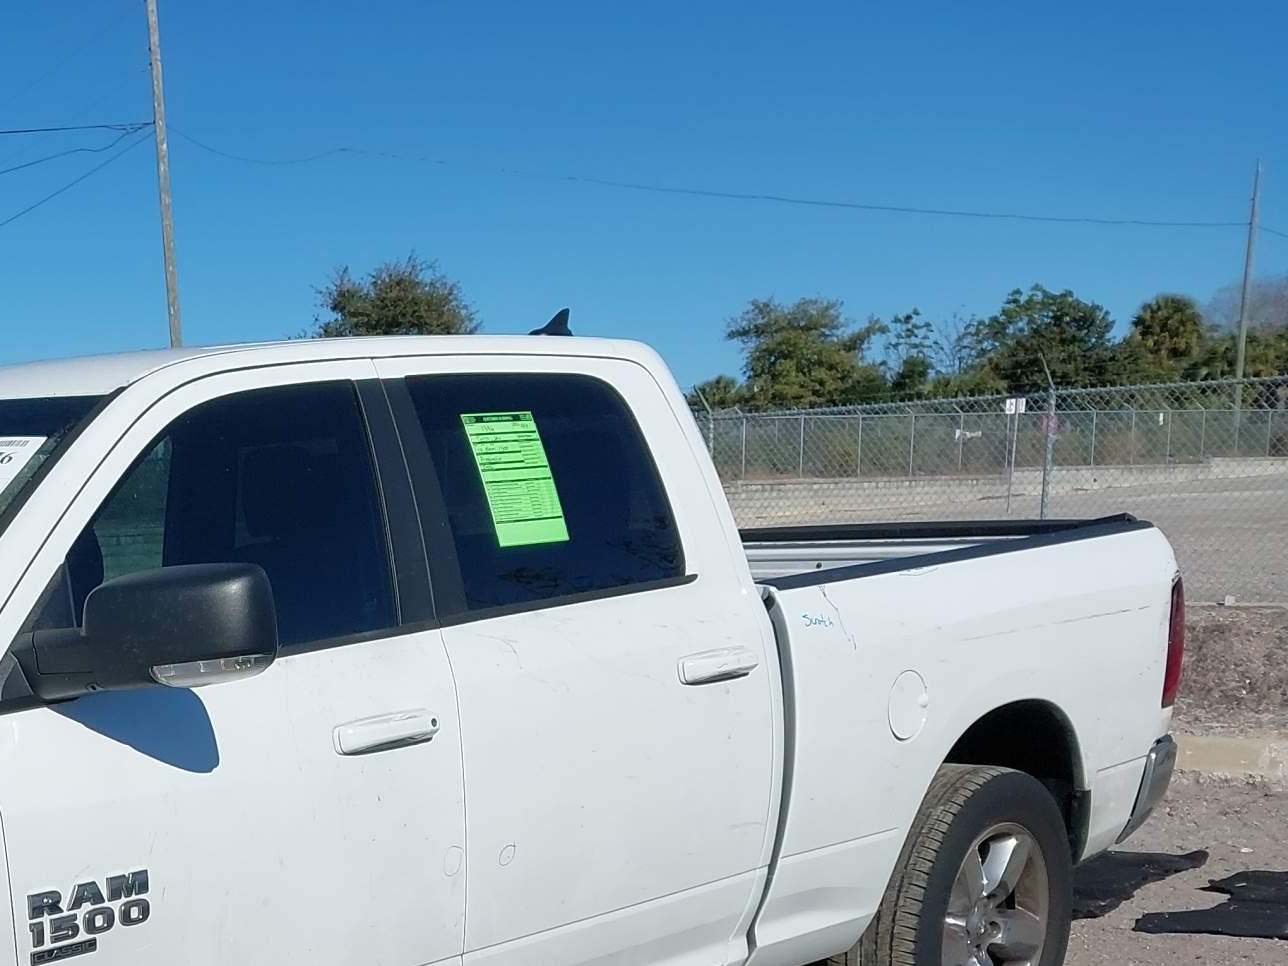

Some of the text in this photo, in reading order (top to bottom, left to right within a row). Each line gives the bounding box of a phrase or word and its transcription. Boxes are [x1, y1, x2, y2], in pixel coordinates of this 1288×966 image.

[26, 869, 149, 921] RAM
[28, 898, 151, 949] 1500
[33, 939, 97, 963] CLASSIC
